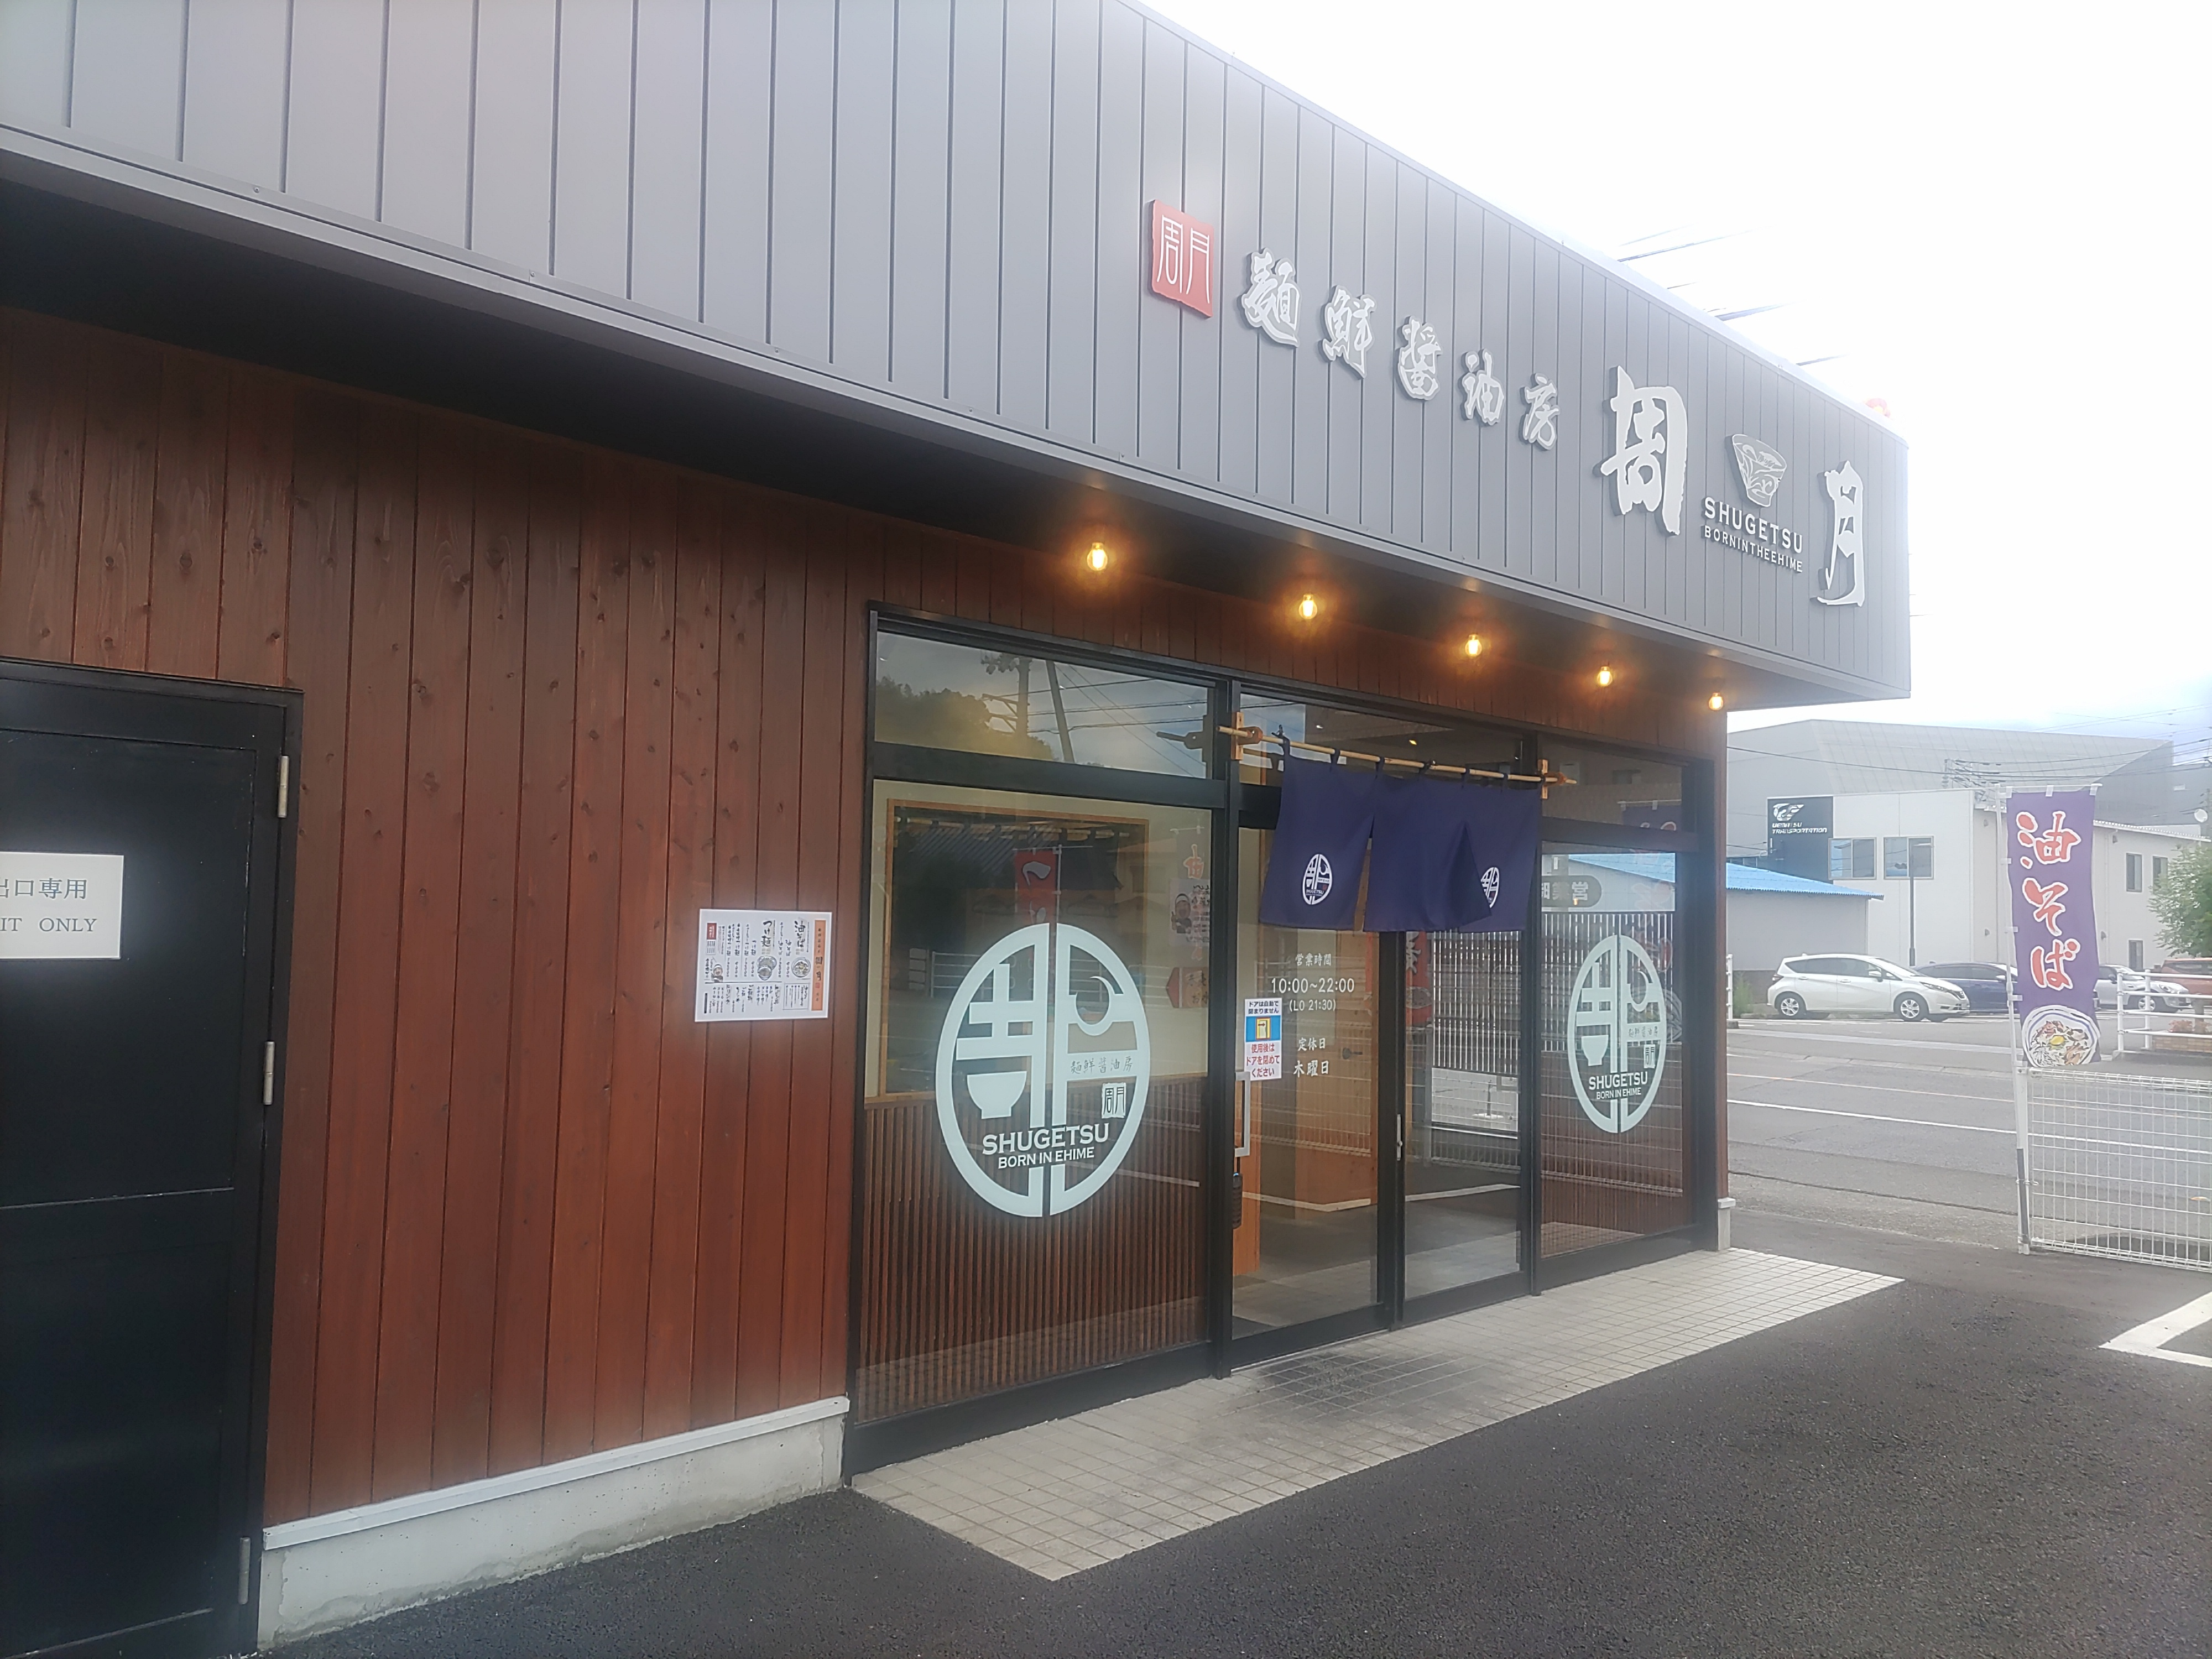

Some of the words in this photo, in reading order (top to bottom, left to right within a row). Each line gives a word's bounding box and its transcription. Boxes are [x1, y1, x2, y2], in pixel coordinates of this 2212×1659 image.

[1705, 497, 1802, 553] SHUGETSU
[2016, 811, 2080, 990] 油そば
[0, 918, 22, 931] IT
[39, 918, 97, 932] ONLY
[760, 920, 773, 947] つけ麺
[1295, 952, 1332, 966] 営業時間
[1308, 999, 1336, 1012] 21:30)
[1251, 1044, 1275, 1053] 使用後は
[1297, 1037, 1326, 1051] 定休日
[1246, 1055, 1280, 1066] ドアを閉めて
[1251, 1068, 1275, 1078] ください
[1293, 1060, 1329, 1078] 木曜日
[1589, 1071, 1648, 1090] SHUGETSU
[1597, 1090, 1614, 1099] BORN
[1623, 1087, 1641, 1097] EHIME
[982, 1123, 1109, 1155] SHUGETSU
[998, 1153, 1036, 1169] BORN
[1039, 1151, 1052, 1164] IN
[1055, 1146, 1094, 1162] EHIME
